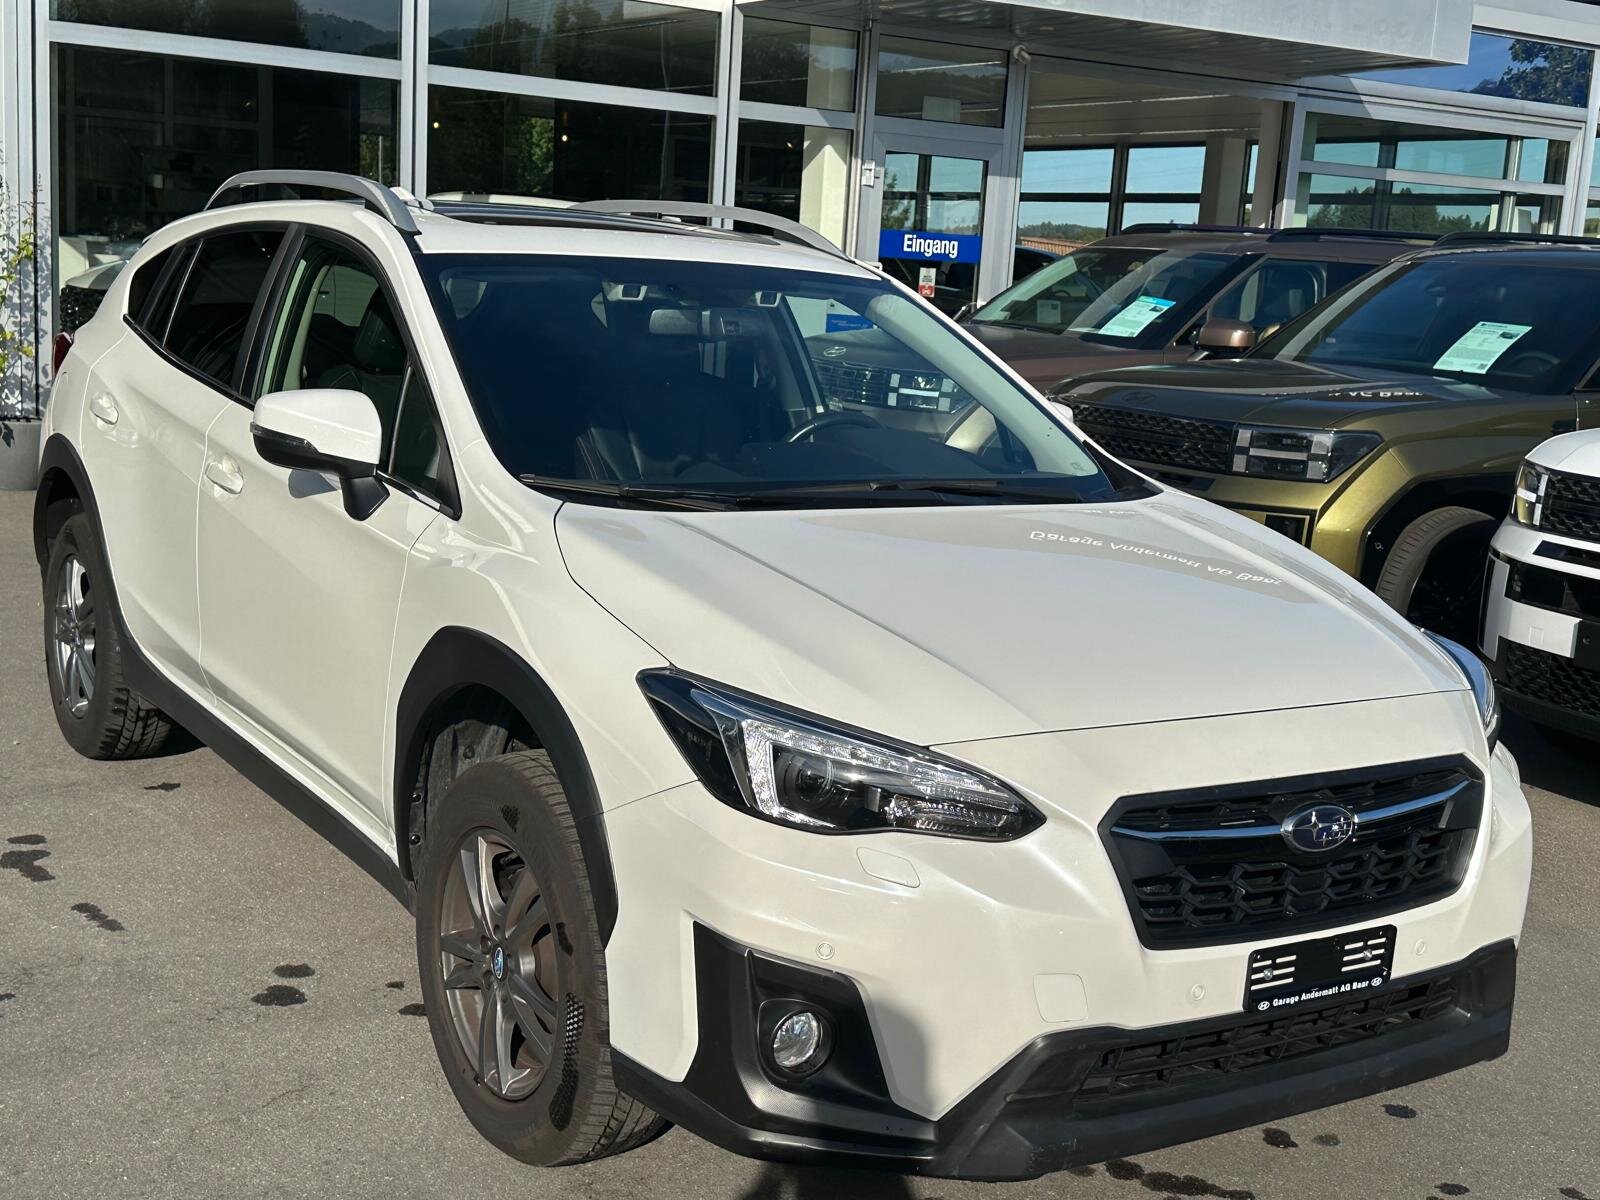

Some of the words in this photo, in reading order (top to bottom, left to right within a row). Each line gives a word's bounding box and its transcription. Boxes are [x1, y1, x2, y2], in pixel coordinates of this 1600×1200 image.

[903, 234, 958, 258] Eingang
[1272, 994, 1300, 1007] Garage
[1301, 986, 1338, 1000] Andermatt
[1340, 983, 1351, 992] AG
[1352, 980, 1370, 990] Baar
